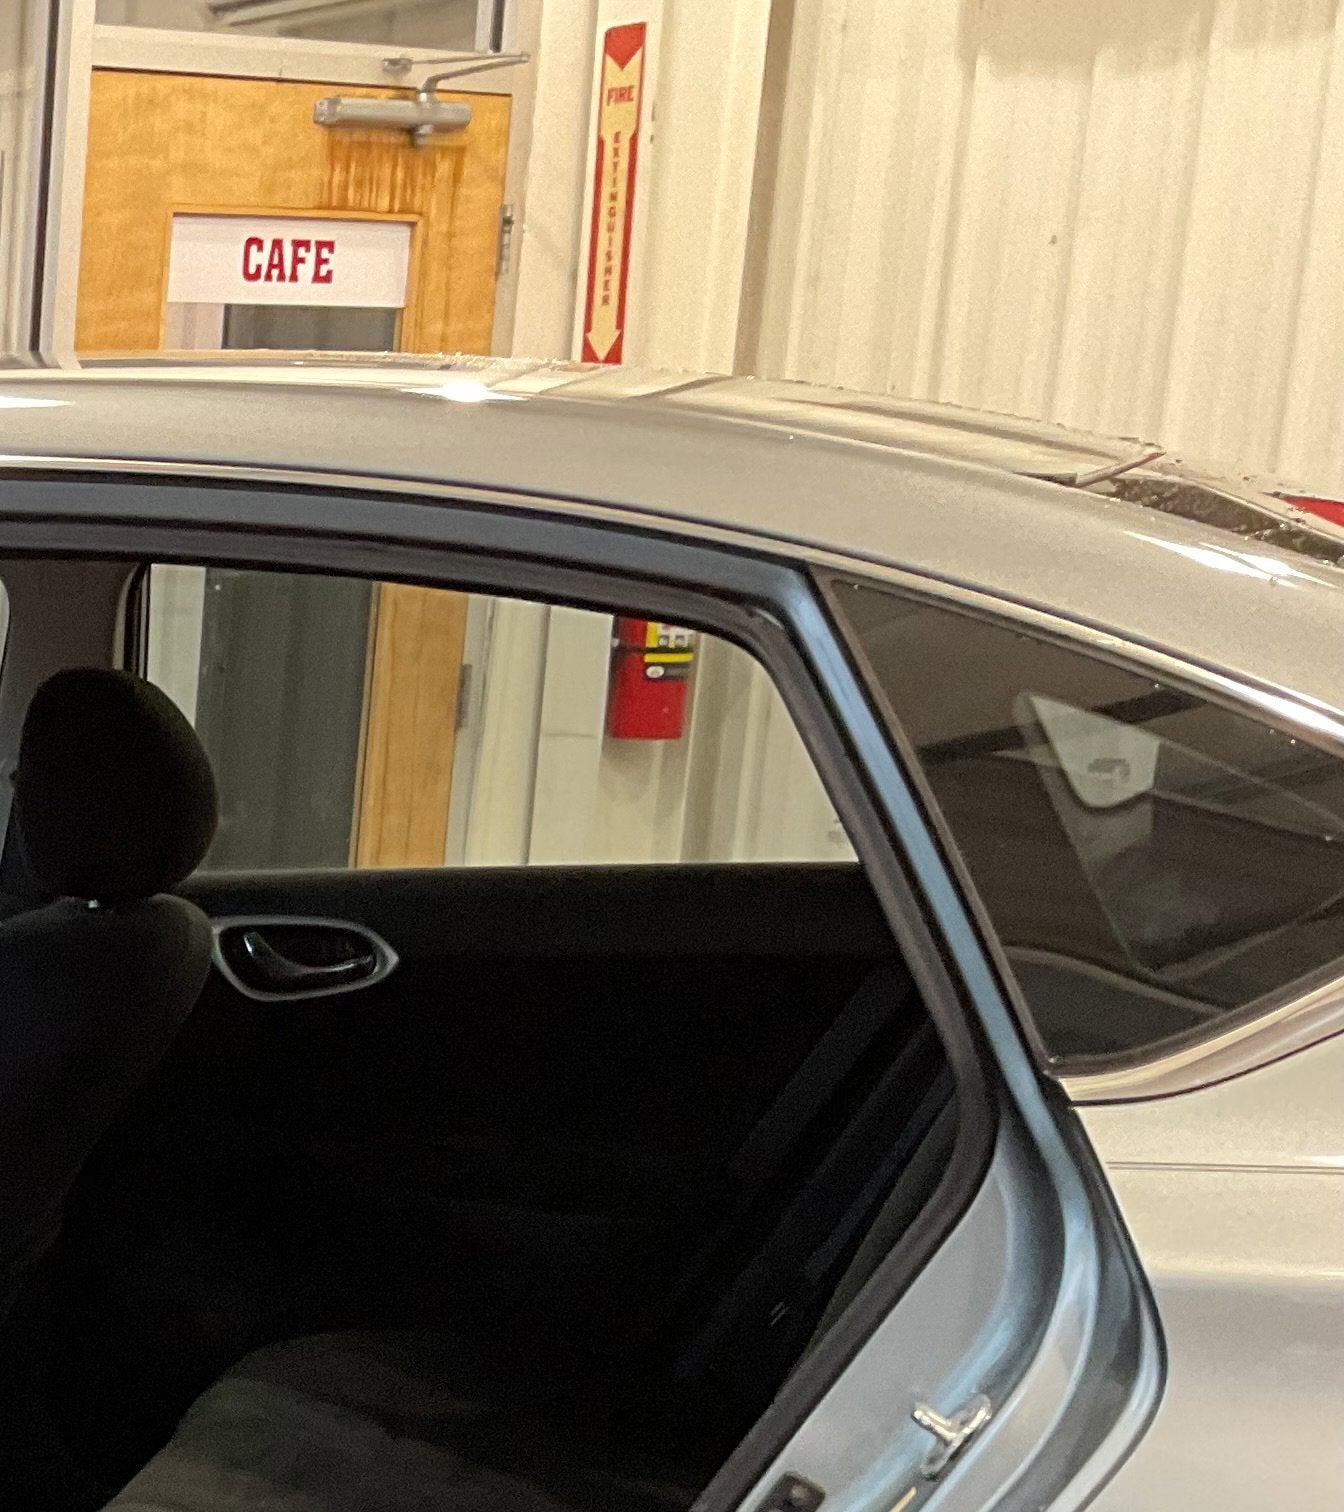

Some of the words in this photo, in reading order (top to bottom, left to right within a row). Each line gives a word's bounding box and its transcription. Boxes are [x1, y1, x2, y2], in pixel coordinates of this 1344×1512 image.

[607, 86, 635, 106] FIRE
[602, 131, 621, 306] EXTINGUISHER
[242, 236, 336, 284] CAFE
